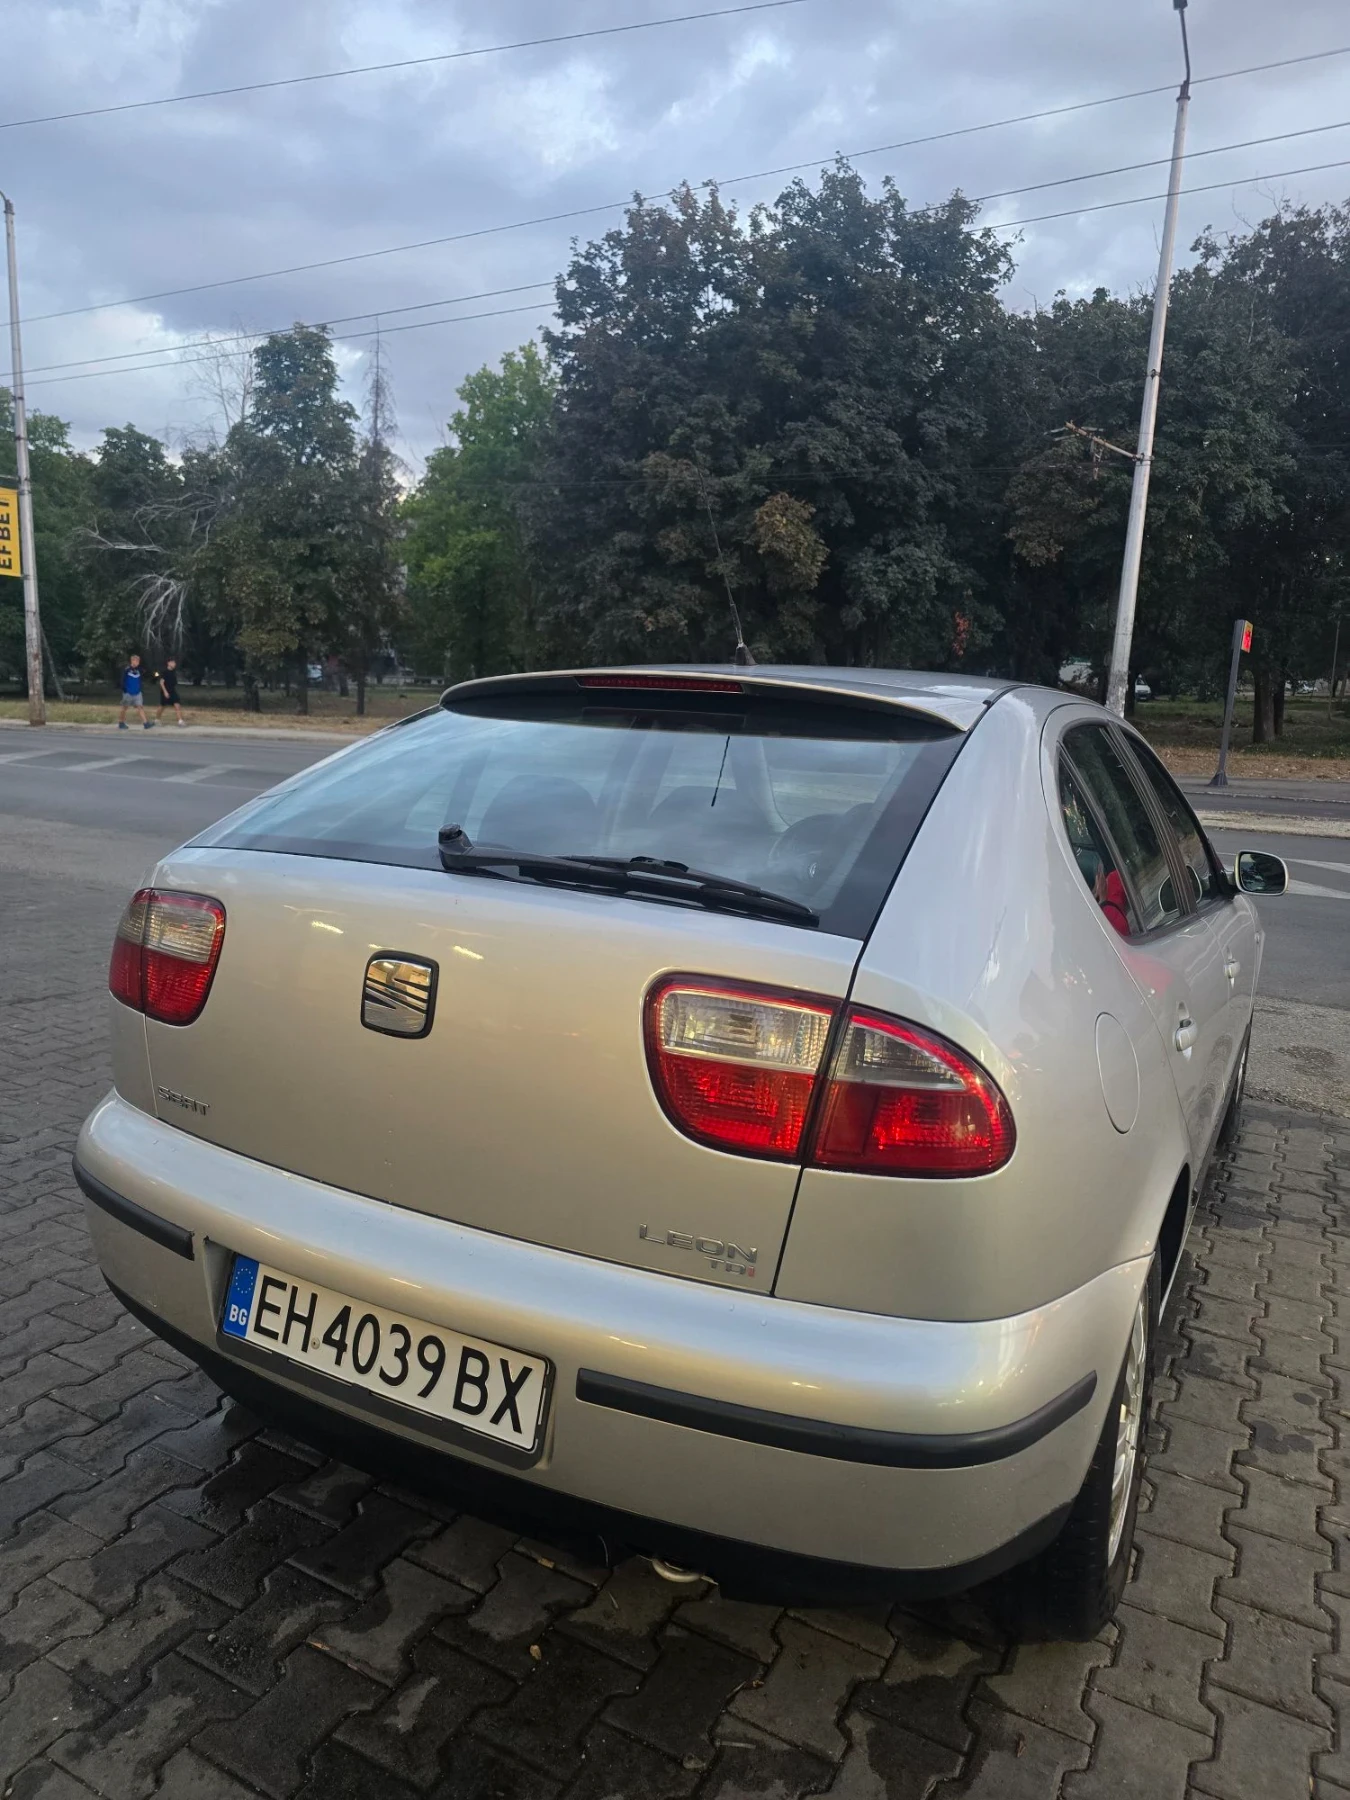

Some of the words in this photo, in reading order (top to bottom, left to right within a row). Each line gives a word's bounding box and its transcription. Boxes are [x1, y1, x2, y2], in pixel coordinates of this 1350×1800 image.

[159, 1086, 210, 1116] SEAT
[639, 1223, 757, 1263] LEON
[230, 1304, 248, 1326] BG
